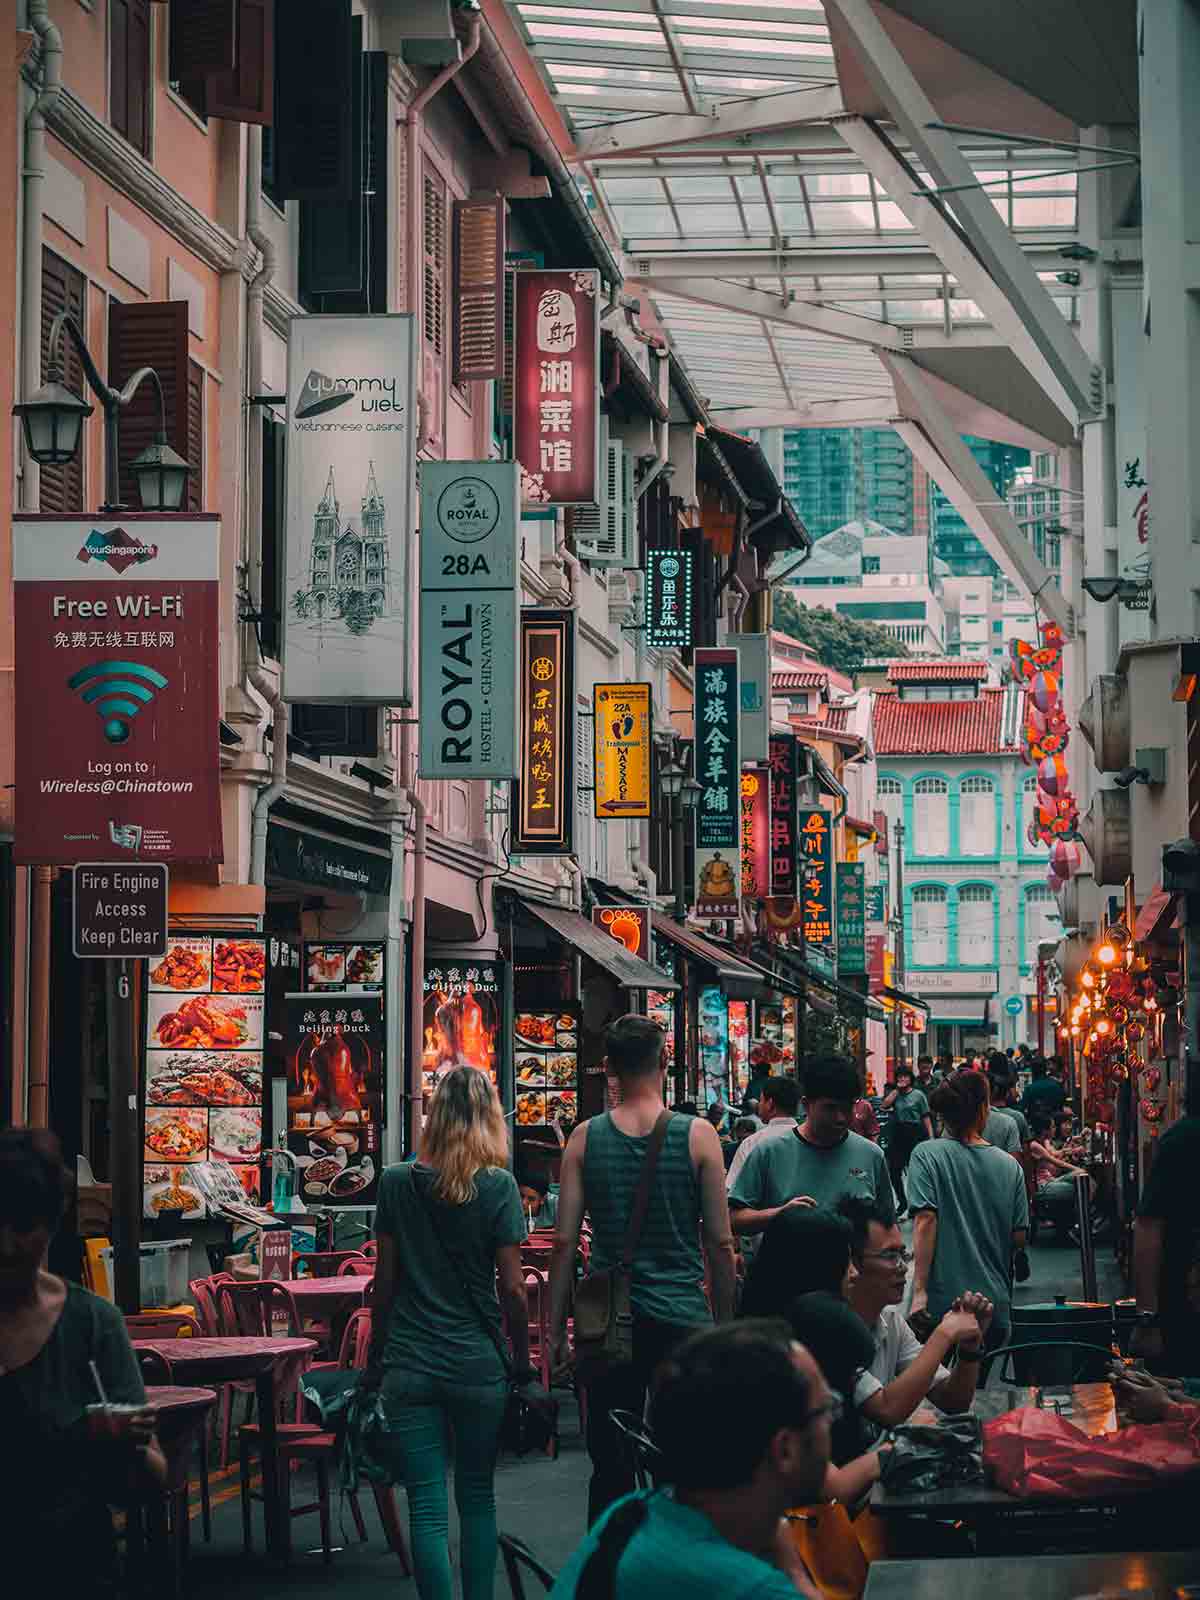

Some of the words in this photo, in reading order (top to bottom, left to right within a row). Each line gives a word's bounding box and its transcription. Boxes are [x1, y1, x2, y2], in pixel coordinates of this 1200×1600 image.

[308, 376, 396, 396] yummy
[539, 360, 572, 472] 湘菜馆
[447, 510, 489, 520] ROYAL
[86, 544, 154, 555] YourSingapore
[441, 554, 491, 576] 28A
[53, 595, 108, 617] Free
[115, 595, 182, 617] Wi-Fi
[54, 631, 175, 648] 免费无线互联网
[480, 603, 492, 696] CHINATOWN
[441, 604, 472, 763] ROYAL
[614, 703, 631, 712] 22A
[480, 708, 492, 762] HOSTEL
[88, 760, 112, 775] Log
[115, 763, 132, 773] on
[135, 761, 149, 773] to
[617, 747, 629, 800] MASSAGE
[40, 779, 194, 794] Wireless@Chinatown
[82, 873, 108, 889] Fire
[114, 873, 159, 893] Engine
[96, 900, 147, 916] Access
[82, 928, 115, 949] Keep
[120, 928, 159, 944] Clear
[423, 982, 470, 993] Beijing
[299, 1024, 338, 1034] Beijing
[344, 1024, 370, 1032] Duck
